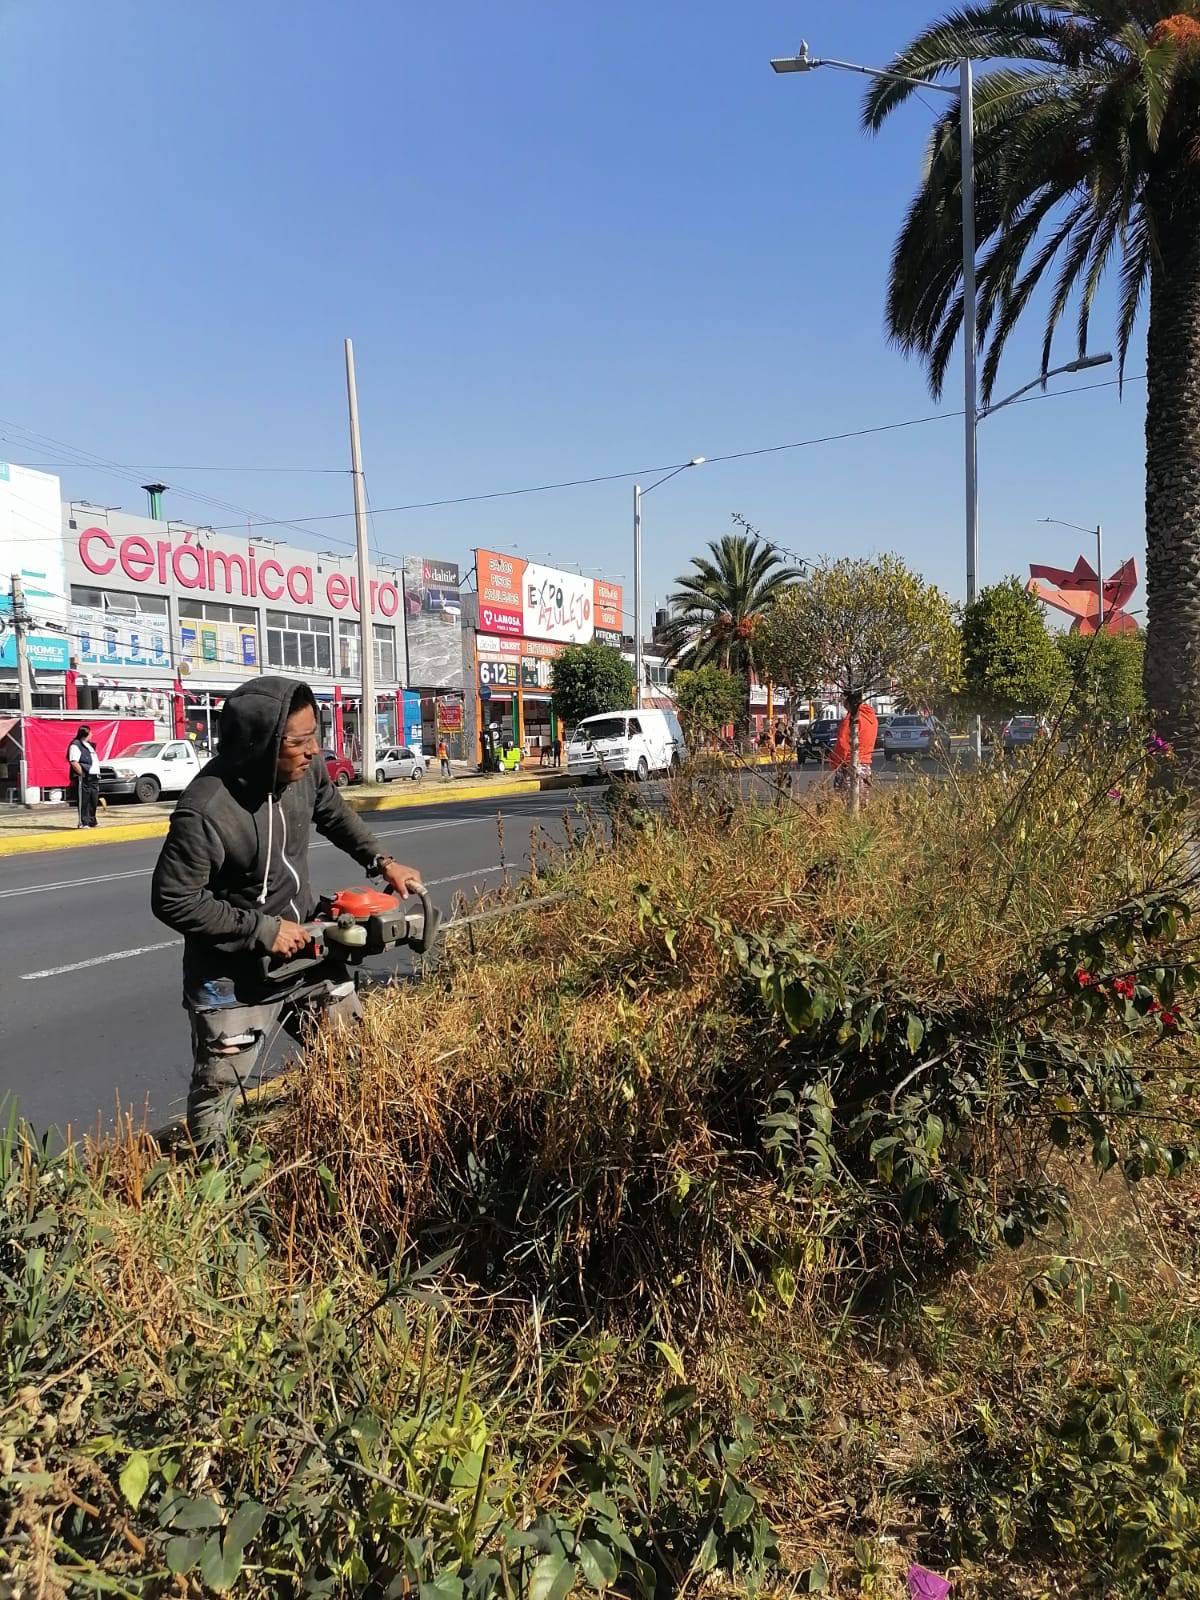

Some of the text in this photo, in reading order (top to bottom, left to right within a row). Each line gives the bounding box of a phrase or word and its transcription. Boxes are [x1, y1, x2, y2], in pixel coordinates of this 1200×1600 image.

[79, 527, 399, 617] cerámica euro
[528, 579, 563, 609] EXPO
